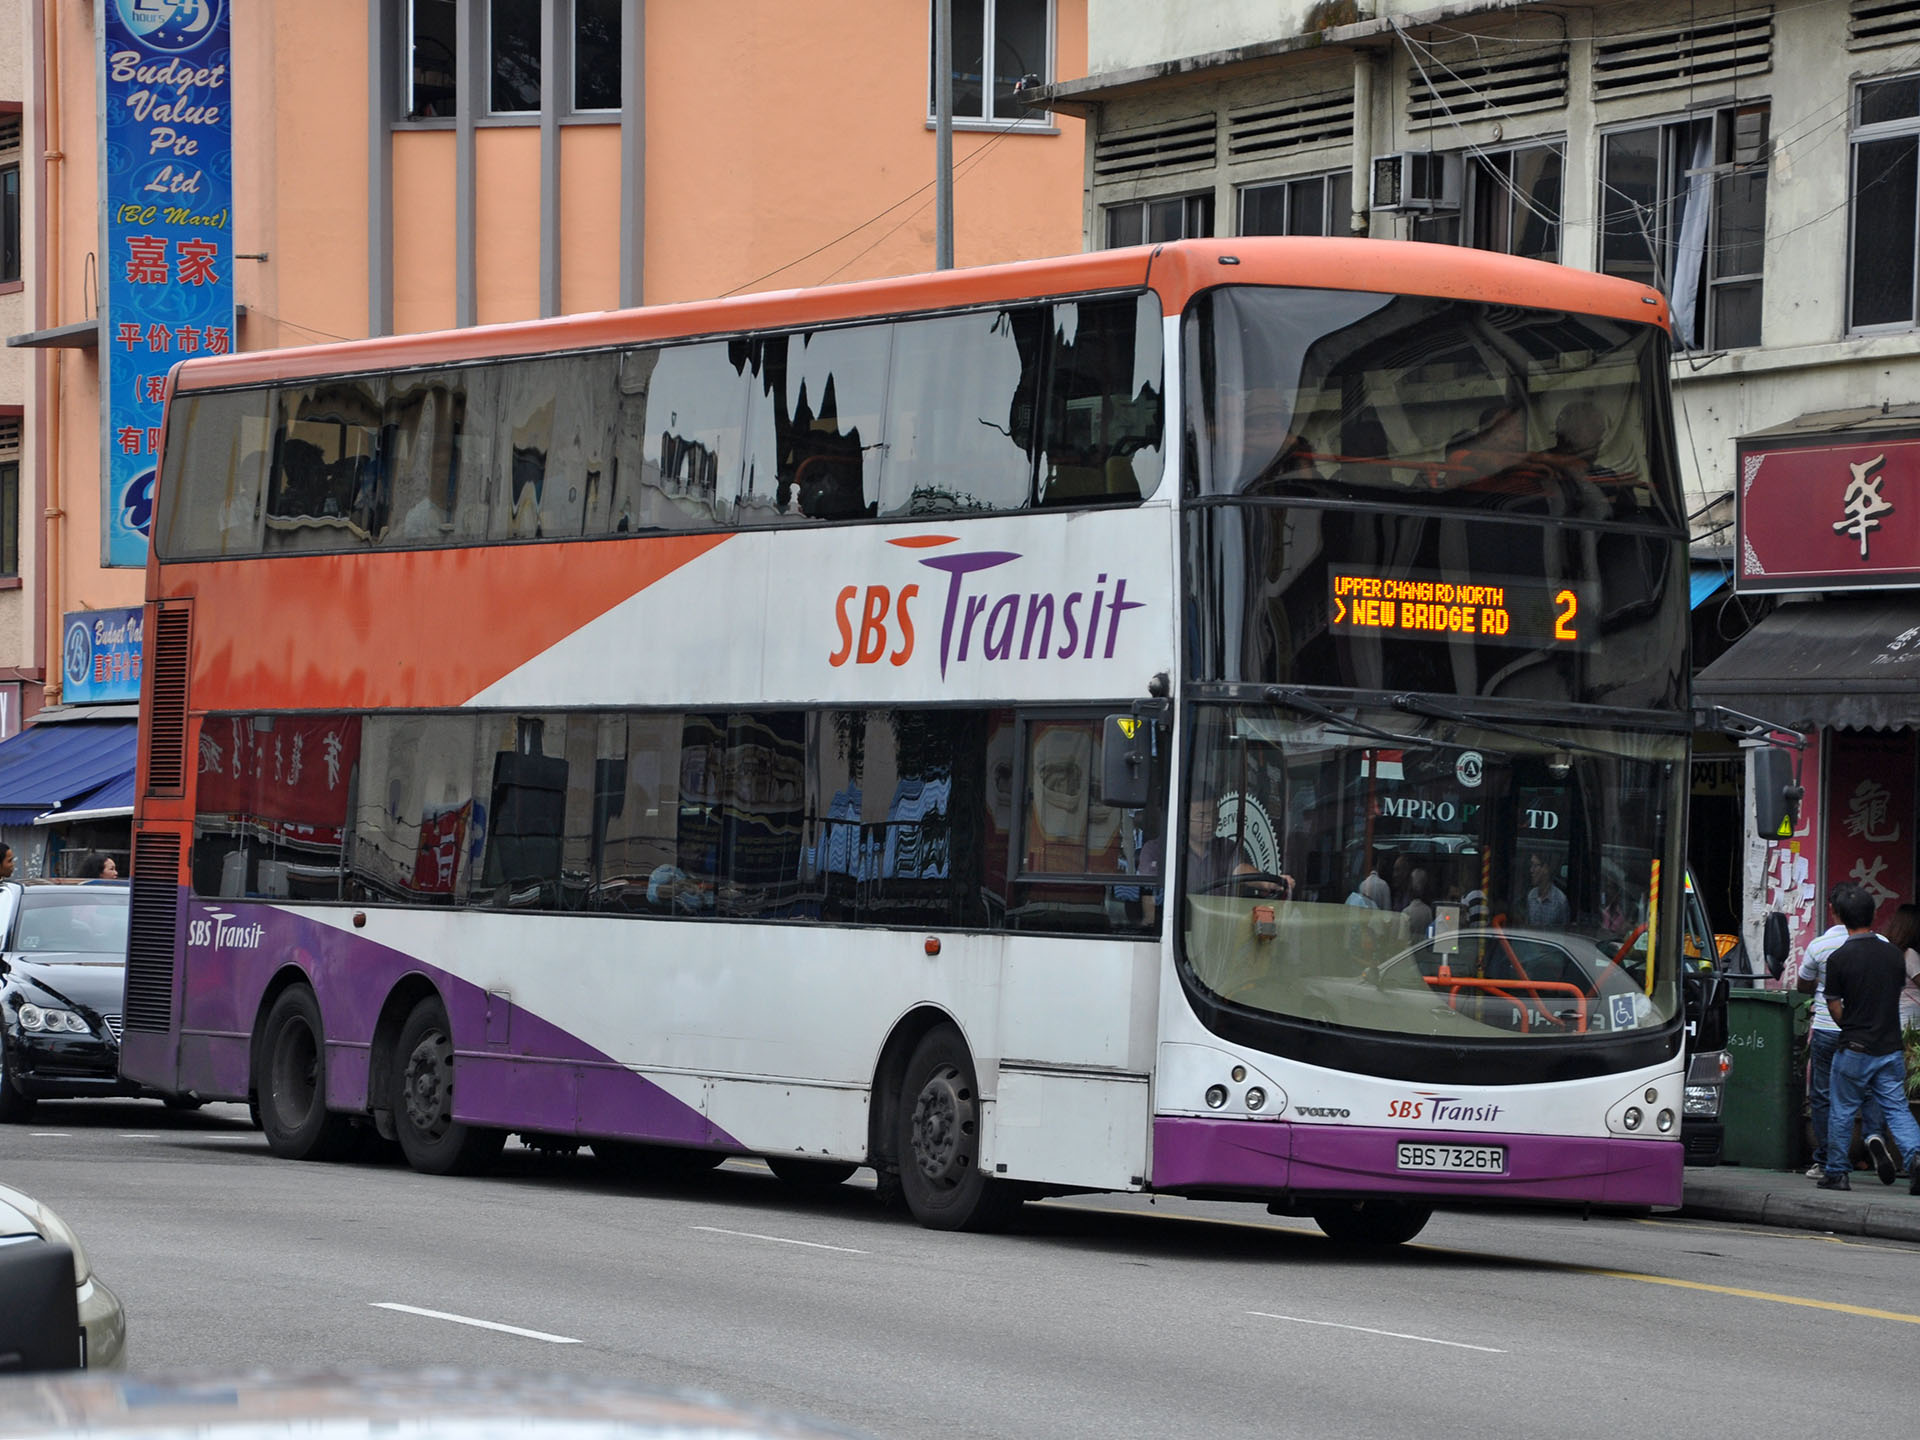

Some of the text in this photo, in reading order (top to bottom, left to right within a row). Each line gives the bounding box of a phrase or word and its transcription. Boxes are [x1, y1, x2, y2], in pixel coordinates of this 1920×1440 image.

[132, 10, 165, 23] hours
[110, 50, 225, 95] Budget
[126, 89, 220, 125] Value
[149, 126, 198, 156] Pte
[144, 165, 201, 194] Ltd
[117, 204, 227, 229] (BC Mart)
[125, 234, 220, 286] 嘉家
[116, 323, 229, 354] 平价市场
[1334, 576, 1504, 606] UPPER CHANGI RD NORTH
[828, 551, 1147, 684] SBS Transit
[1352, 599, 1509, 635] NEW BRIDGE RD
[1555, 589, 1577, 640] 2
[94, 618, 125, 652] Budget
[1374, 796, 1455, 822] MPRO
[188, 913, 266, 952] SBS Transit
[1295, 1105, 1351, 1119] VOLVO
[1387, 1097, 1504, 1123] SBS Transit
